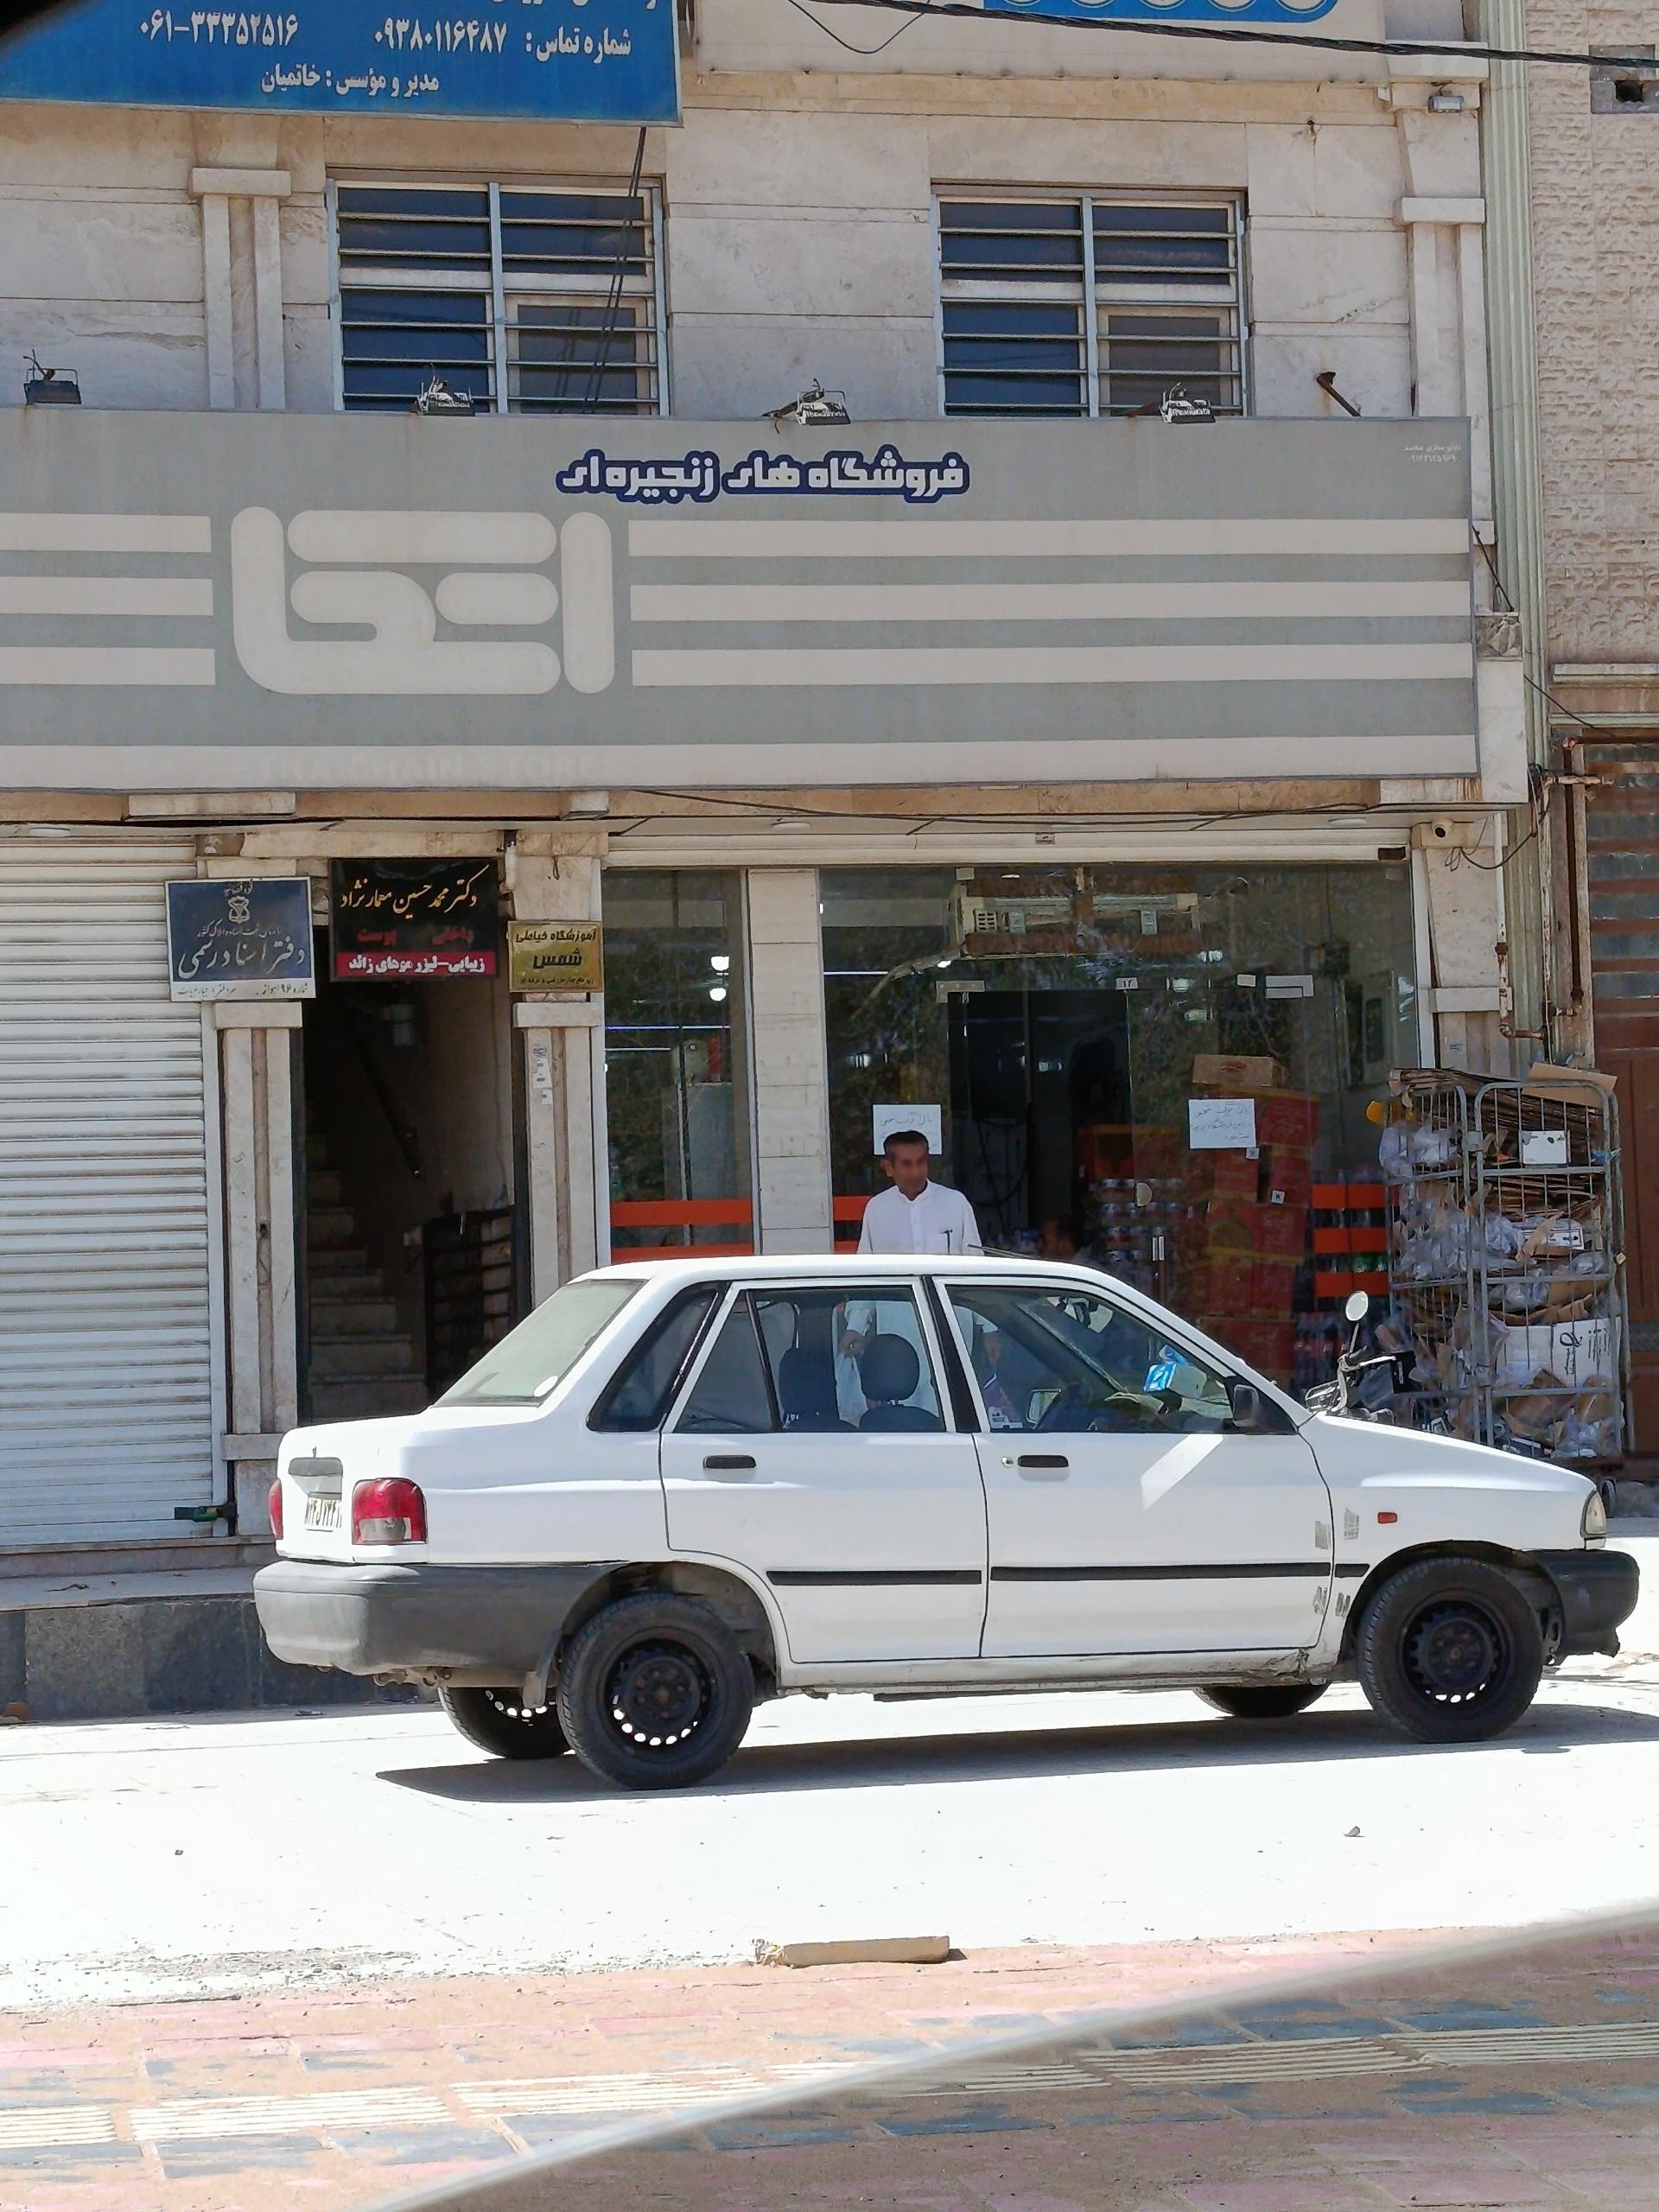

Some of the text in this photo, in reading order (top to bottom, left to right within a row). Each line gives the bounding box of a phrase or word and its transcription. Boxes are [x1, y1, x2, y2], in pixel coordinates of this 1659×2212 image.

[139, 9, 298, 47] ۰۶۱-۳۳۳۵۲۵۱۶
[374, 17, 507, 54] ۰۹۳۸۰۱۱۶۴۸۷
[584, 28, 632, 64] شماره
[261, 62, 321, 92] خاتمیان
[391, 76, 400, 98] و
[403, 73, 440, 98] مدیر
[559, 448, 967, 500] فروشگاه های زنجیره ای
[393, 884, 432, 919] حسین
[429, 888, 449, 908] محمد
[444, 864, 490, 913] دکتر
[516, 928, 597, 944] آموزشگاه خیاطی
[178, 935, 305, 979] دفتر اسناد رسمی
[532, 947, 582, 969] شمس
